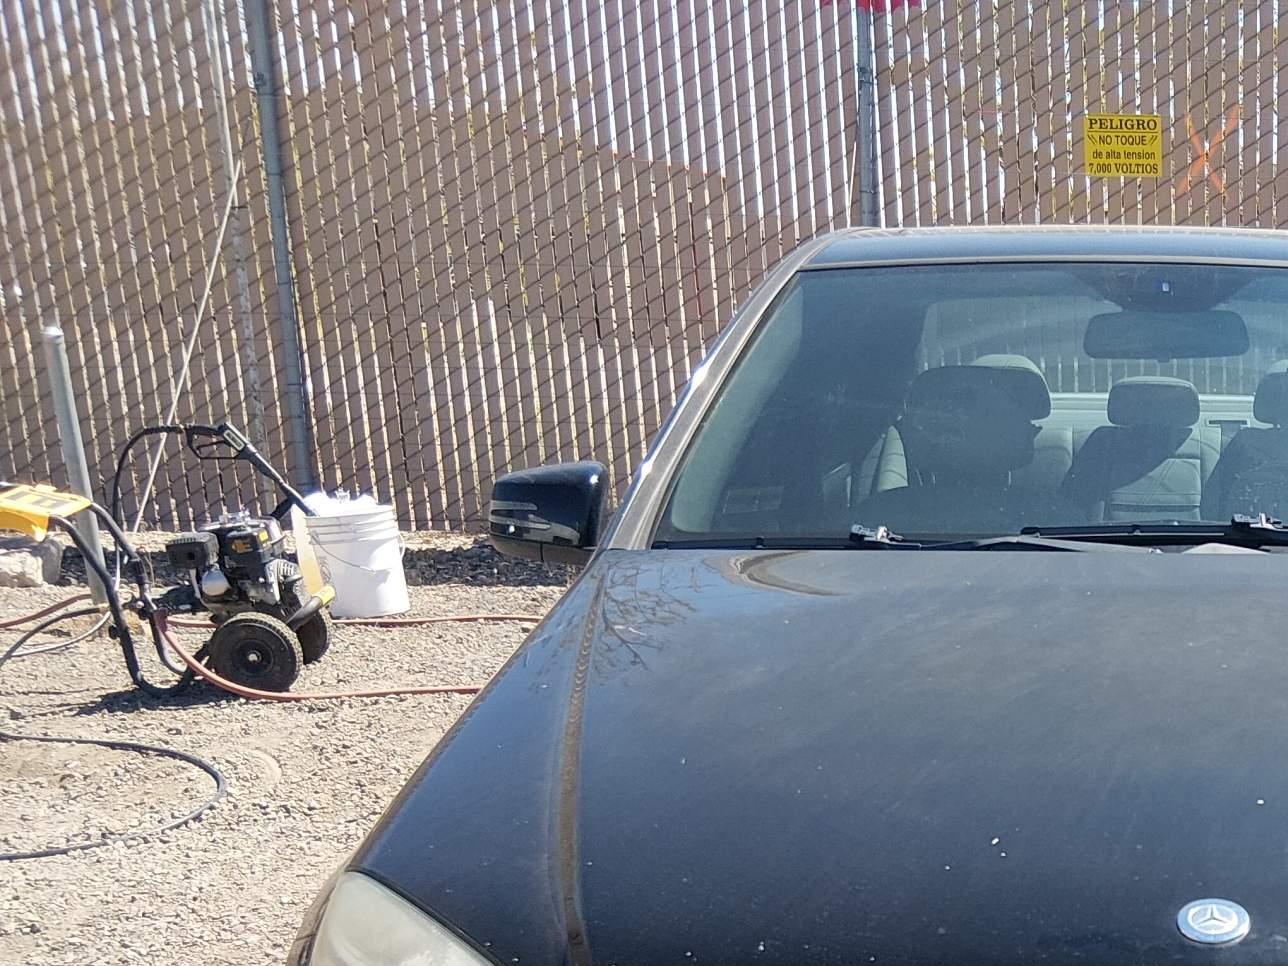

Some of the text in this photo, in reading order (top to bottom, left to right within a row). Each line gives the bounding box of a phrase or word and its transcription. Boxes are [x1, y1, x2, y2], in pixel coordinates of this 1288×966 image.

[1088, 118, 1158, 130] PELIGRO
[1099, 135, 1147, 146] NO TOQUE
[1092, 149, 1155, 160] de alta tension
[1089, 163, 1158, 174] 7,000 VOLTIOS
